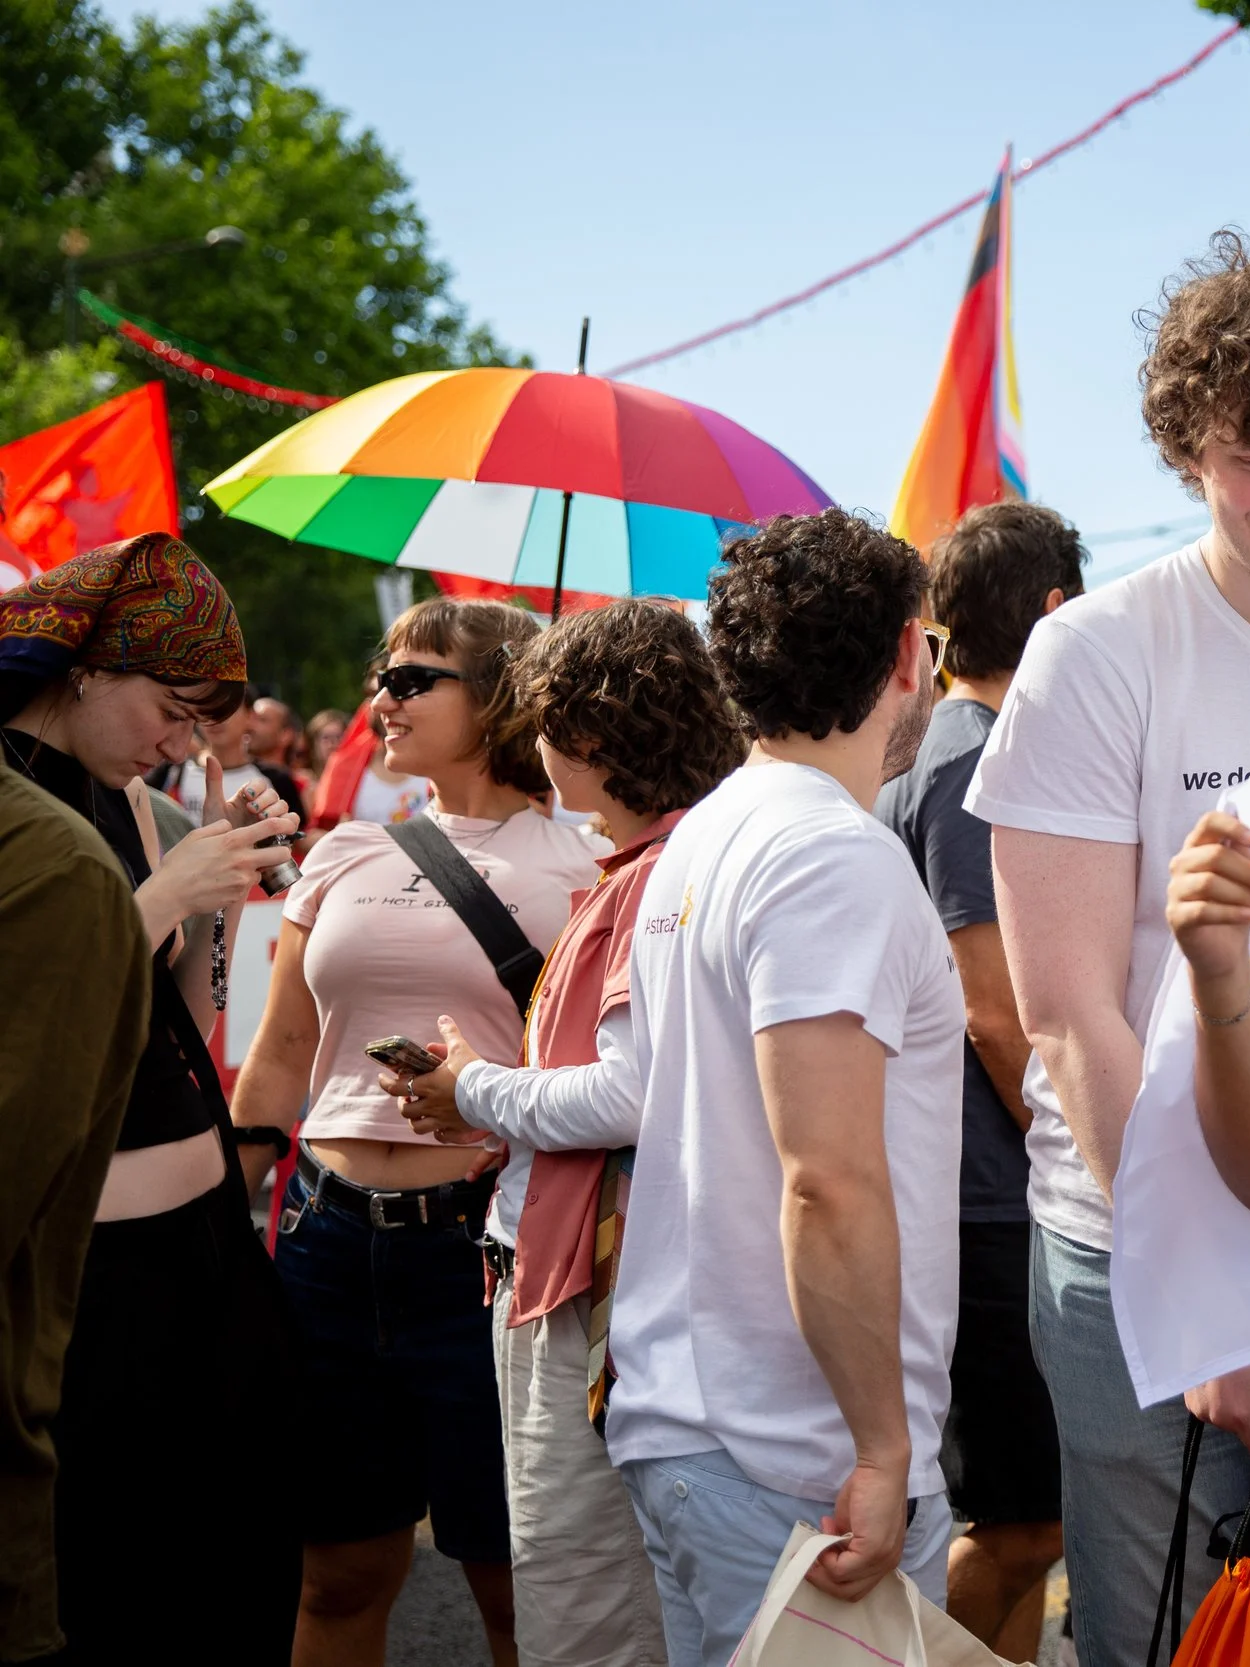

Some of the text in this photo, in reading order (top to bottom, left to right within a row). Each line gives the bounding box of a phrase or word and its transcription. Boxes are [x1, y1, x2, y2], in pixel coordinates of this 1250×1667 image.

[1183, 771, 1222, 791] we
[402, 873, 428, 892] I
[354, 896, 376, 905] MY
[382, 898, 417, 908] HOT
[645, 913, 679, 935] AstraZ
